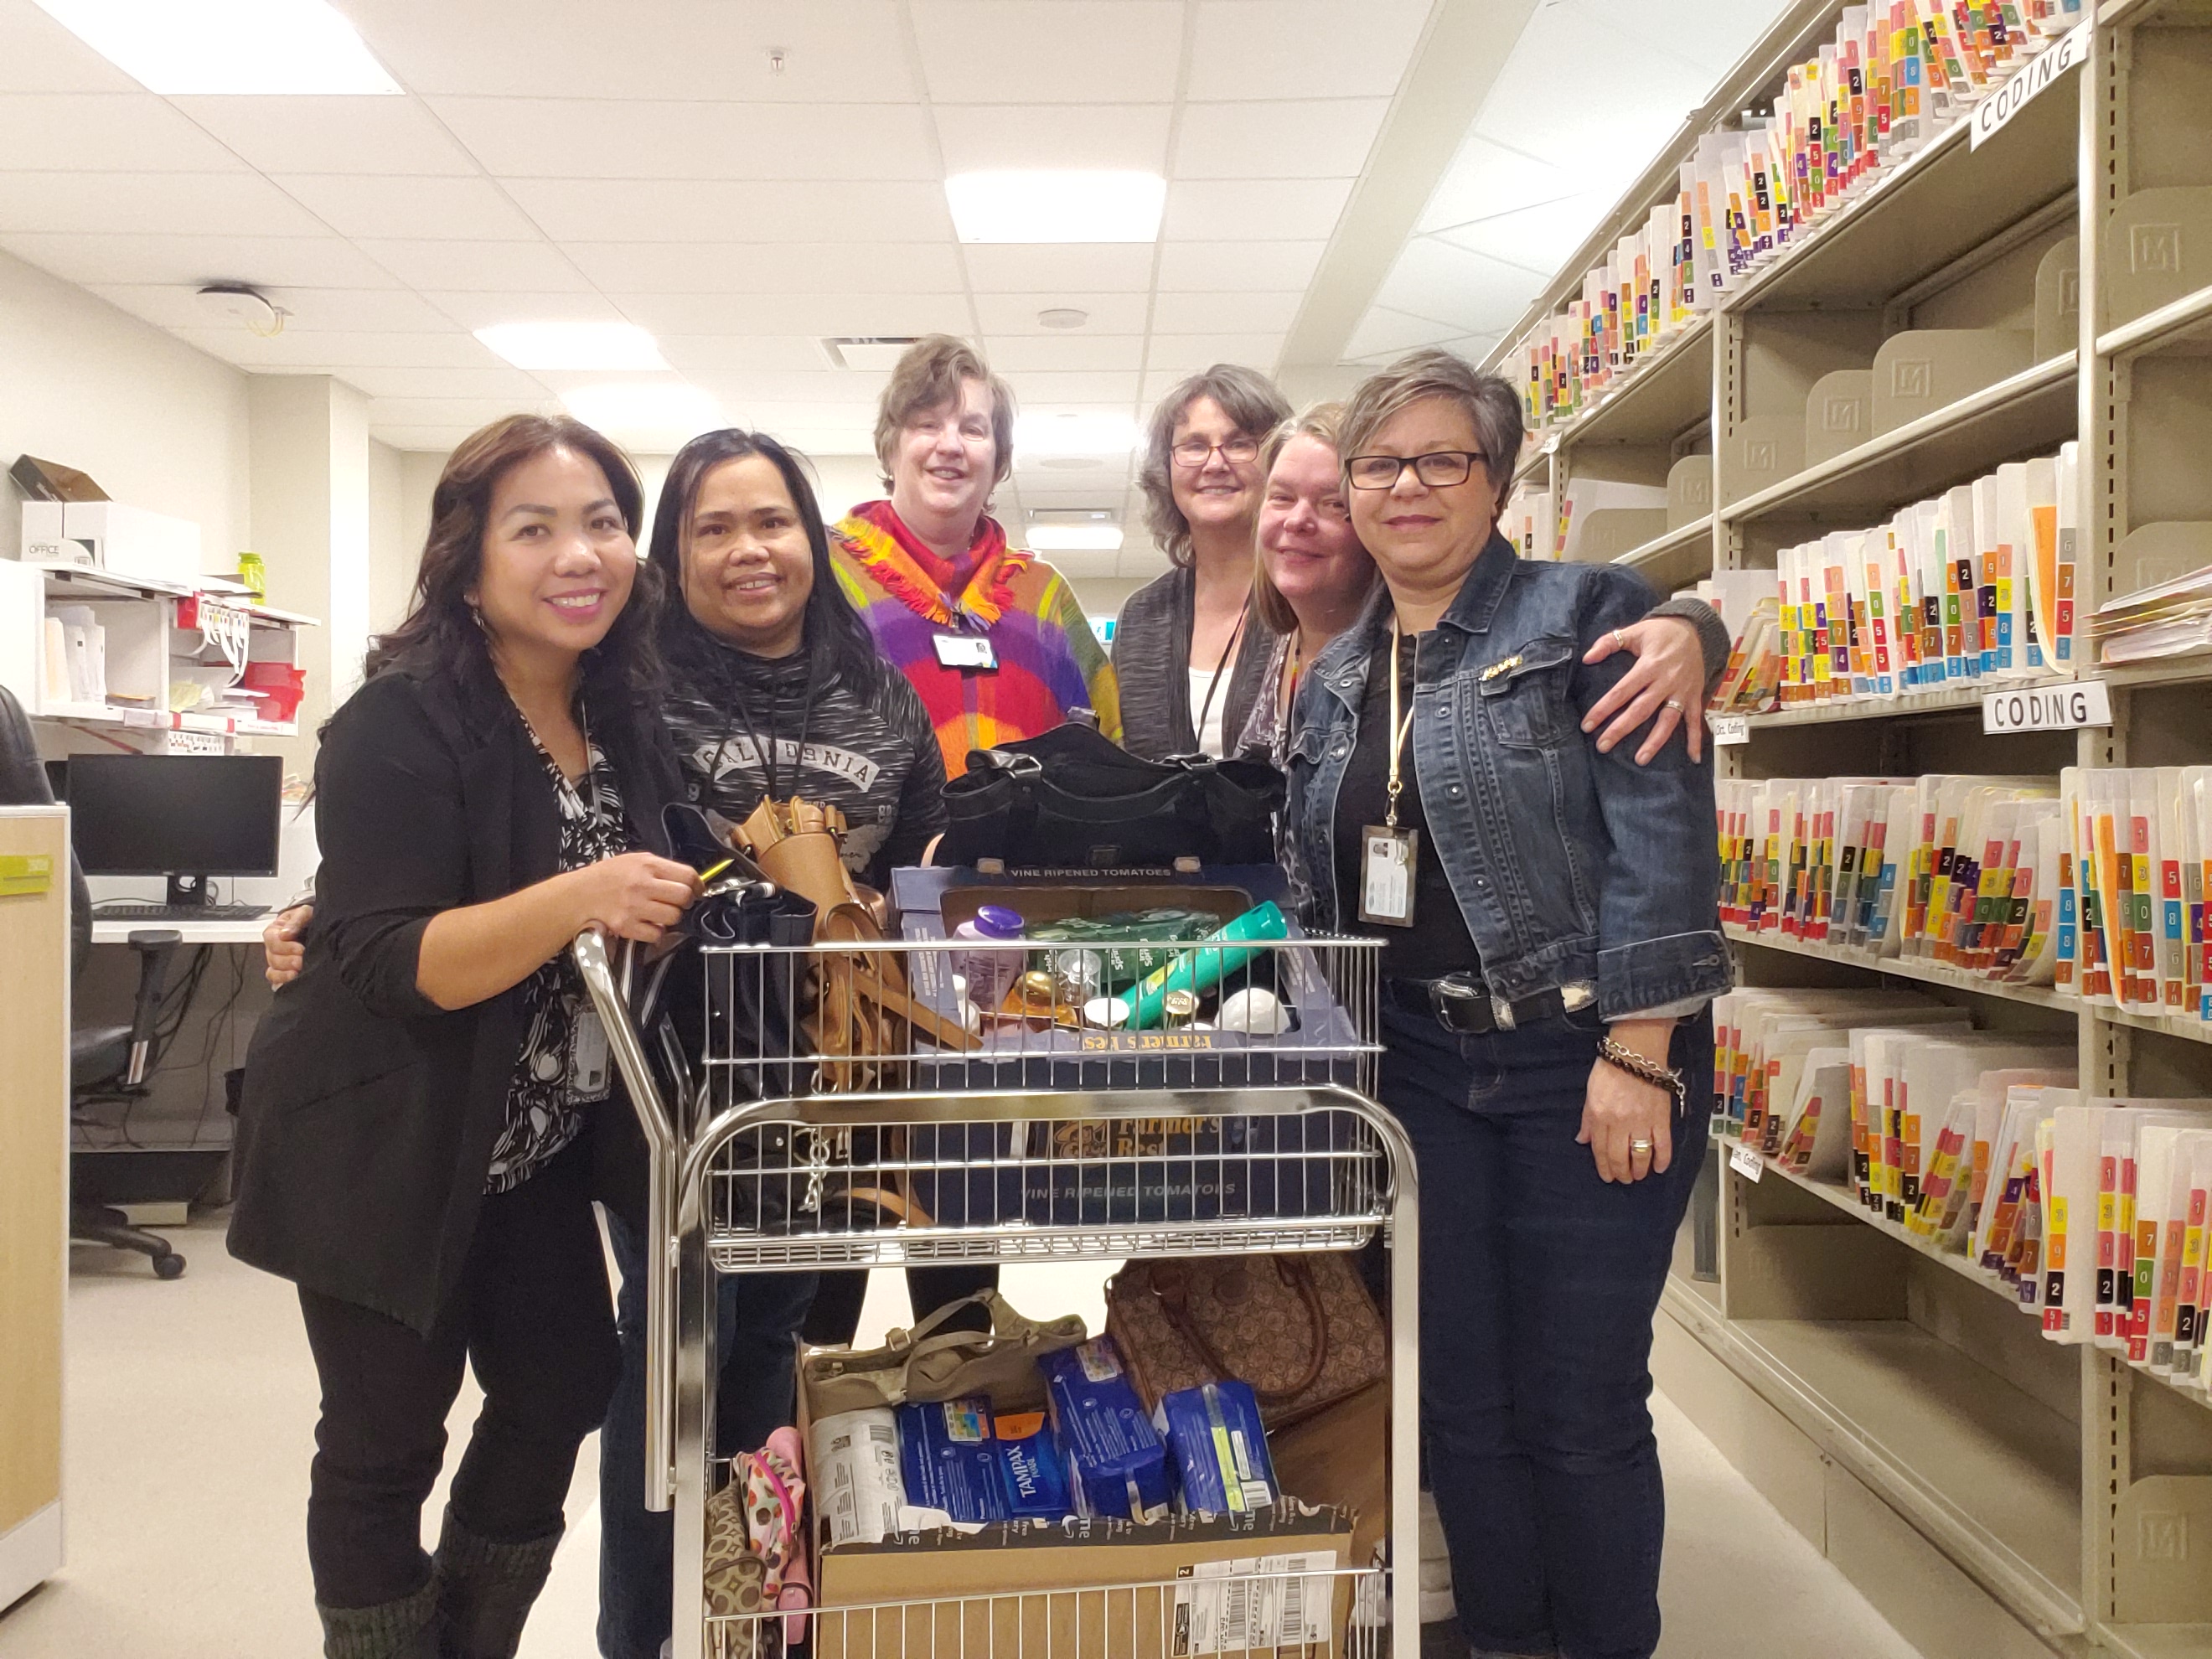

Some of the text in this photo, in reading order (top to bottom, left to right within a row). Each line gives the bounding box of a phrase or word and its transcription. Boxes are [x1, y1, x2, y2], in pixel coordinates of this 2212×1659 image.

[1981, 38, 2072, 132] CODING
[28, 545, 59, 555] OFFICE
[1994, 692, 2087, 726] CODING
[1010, 868, 1171, 877] VINE RIPENED TOMATOES
[1127, 1035, 1213, 1049] Farmers
[1005, 1445, 1037, 1499] TAMPAX
